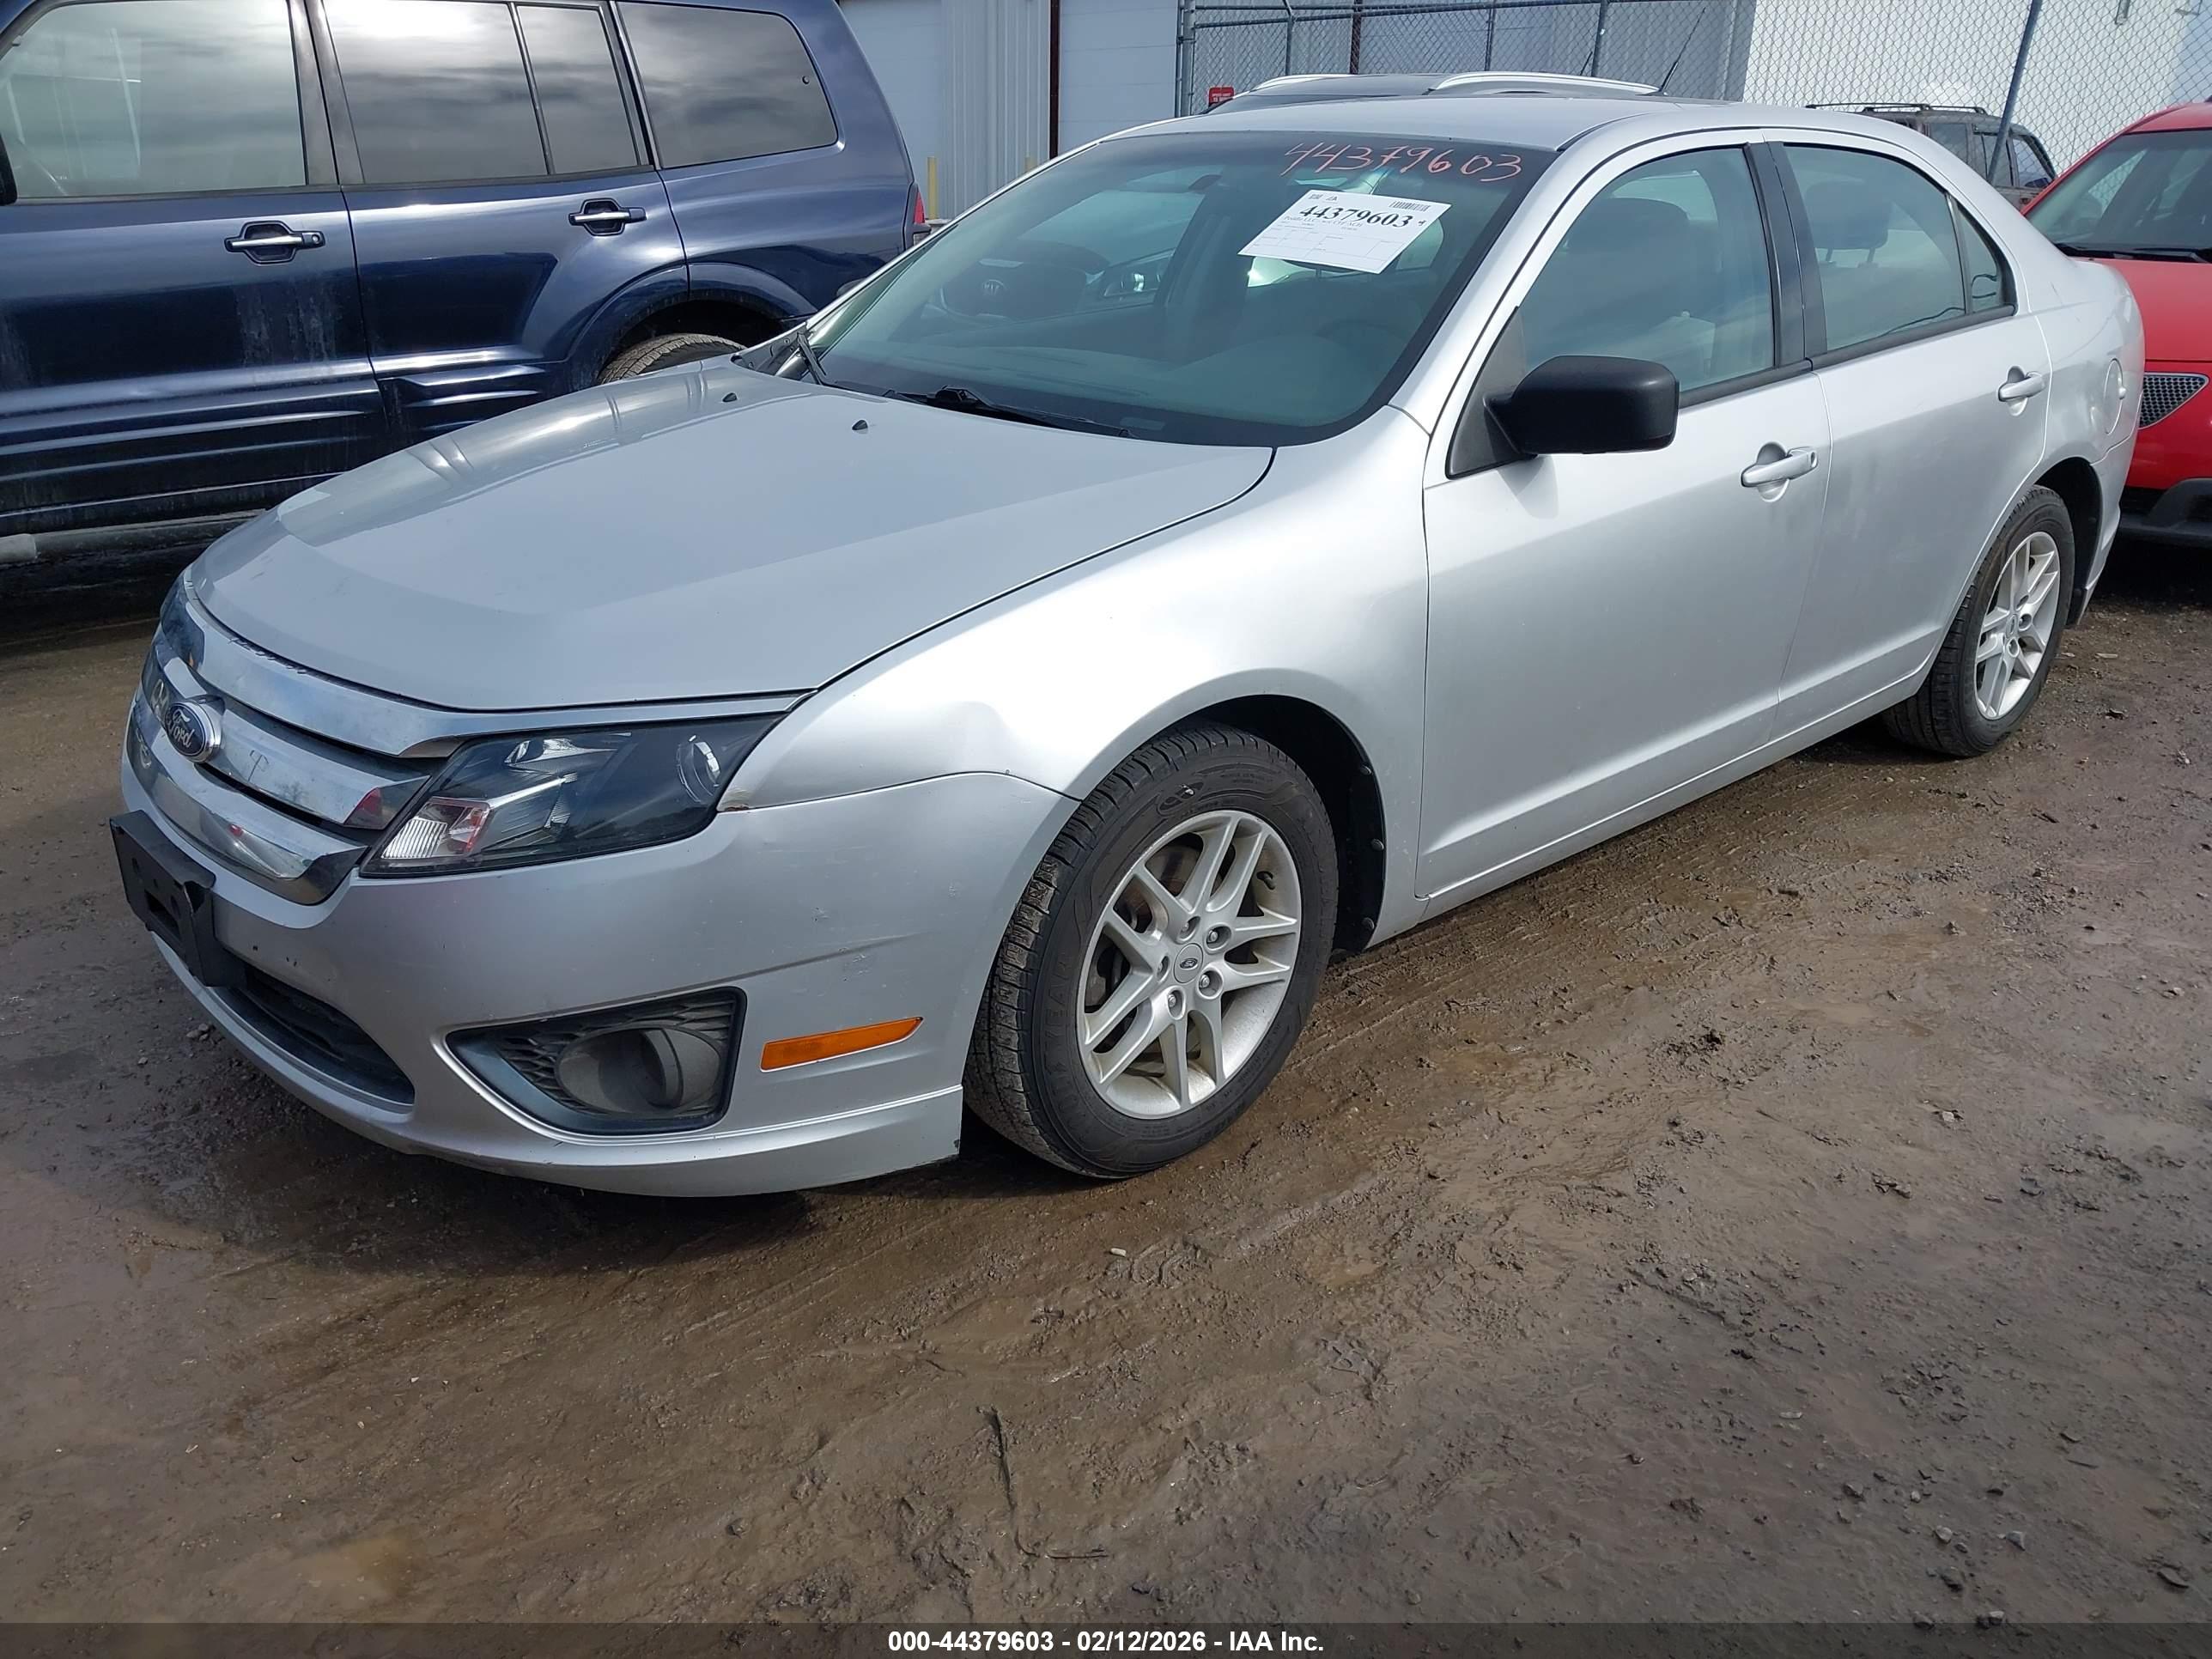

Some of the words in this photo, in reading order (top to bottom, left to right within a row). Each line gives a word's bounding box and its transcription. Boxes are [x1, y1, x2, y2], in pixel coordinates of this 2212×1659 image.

[1281, 142, 1522, 181] 44379603
[1299, 206, 1413, 227] 44379603
[167, 708, 194, 748] Ford
